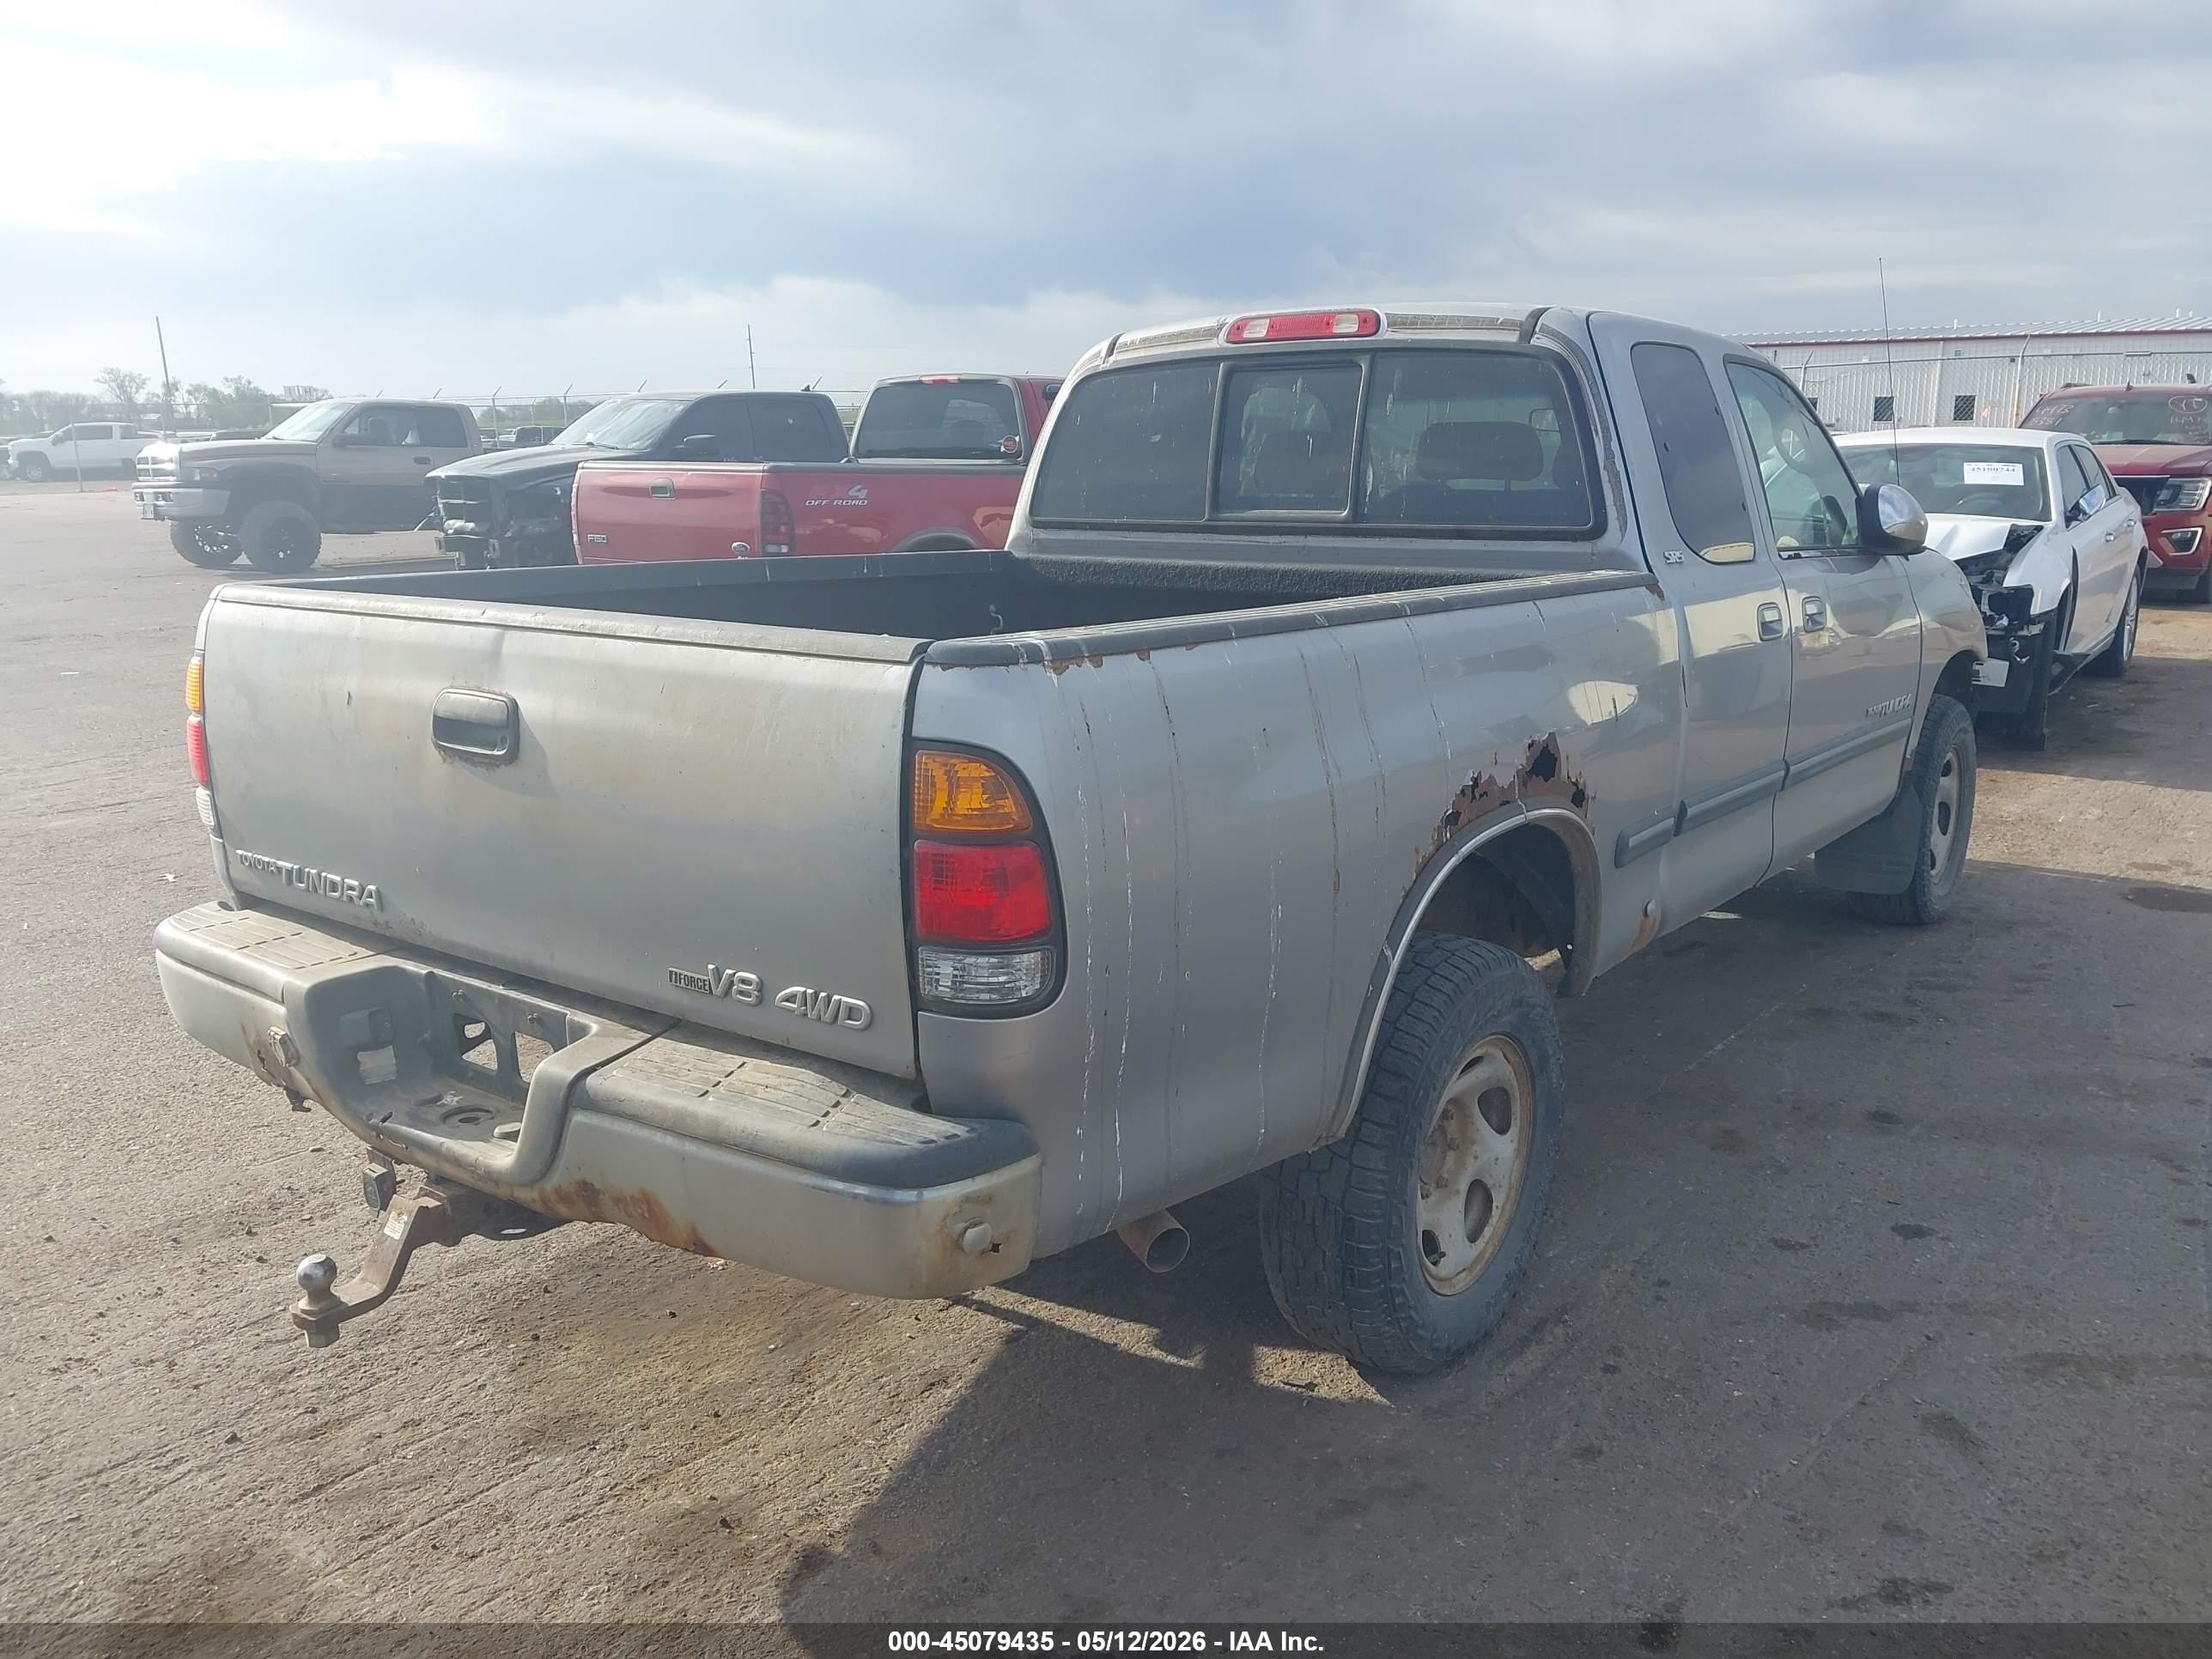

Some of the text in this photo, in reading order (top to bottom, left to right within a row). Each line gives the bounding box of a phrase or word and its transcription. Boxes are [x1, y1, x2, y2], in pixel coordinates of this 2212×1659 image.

[235, 848, 380, 911] TOYOTA TUNDRA
[708, 963, 762, 1006] V8
[775, 986, 872, 1030] 4WD
